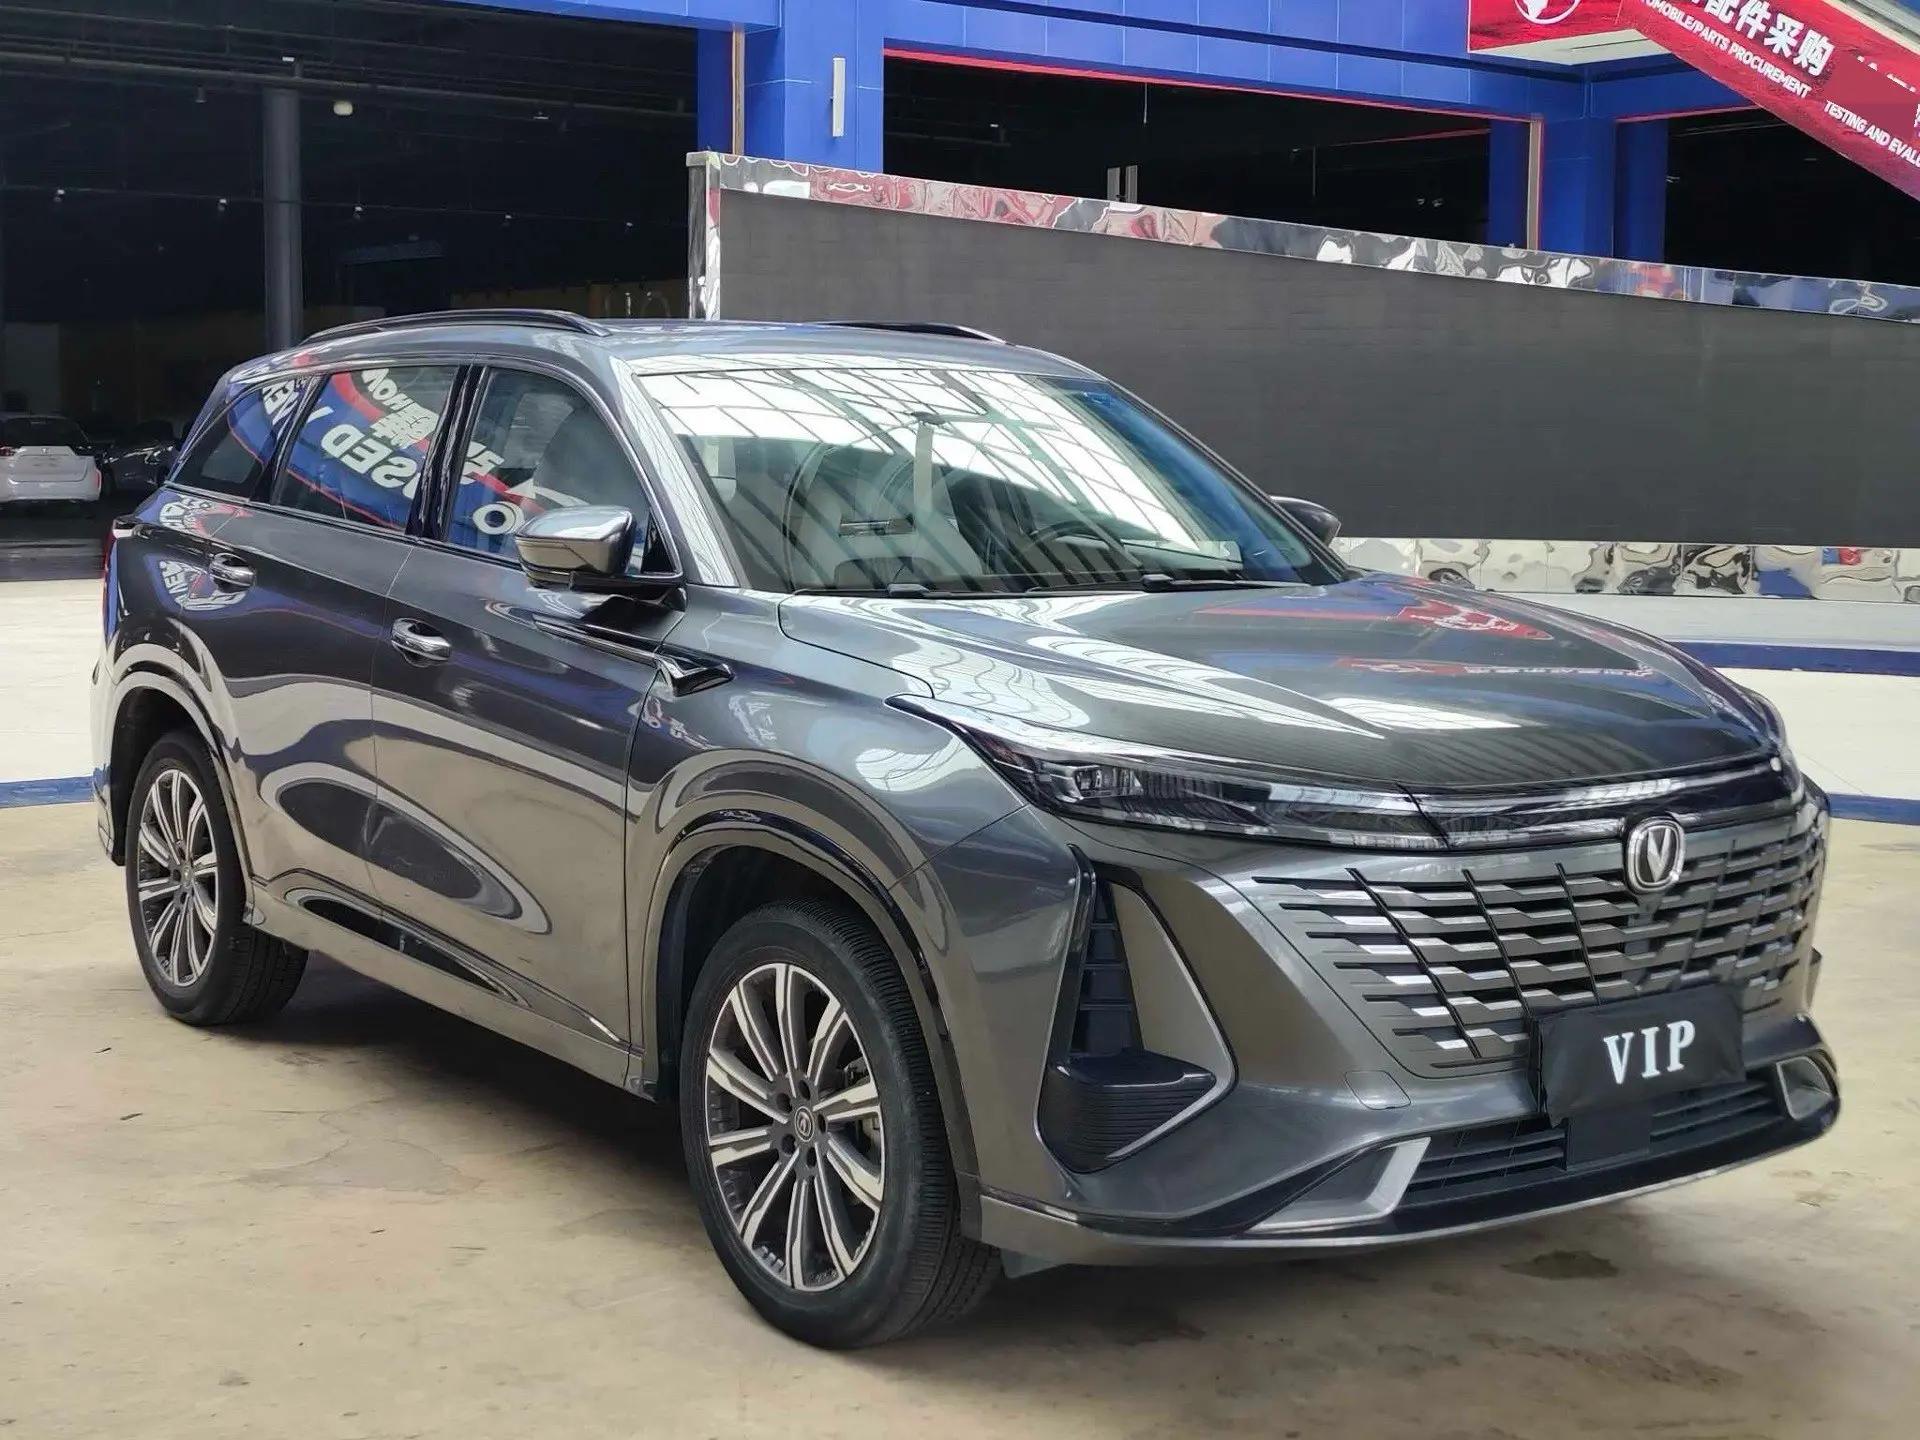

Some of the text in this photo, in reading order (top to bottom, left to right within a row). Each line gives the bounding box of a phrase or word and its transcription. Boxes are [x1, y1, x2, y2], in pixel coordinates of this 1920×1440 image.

[1641, 0, 1731, 51] OMOBILE/PARTS
[1727, 42, 1812, 98] PROCUREMENT
[1691, 0, 1835, 76] 配件采购
[1824, 100, 1868, 133] TESTING
[1864, 125, 1891, 146] AND
[1603, 1020, 1695, 1084] VIP
